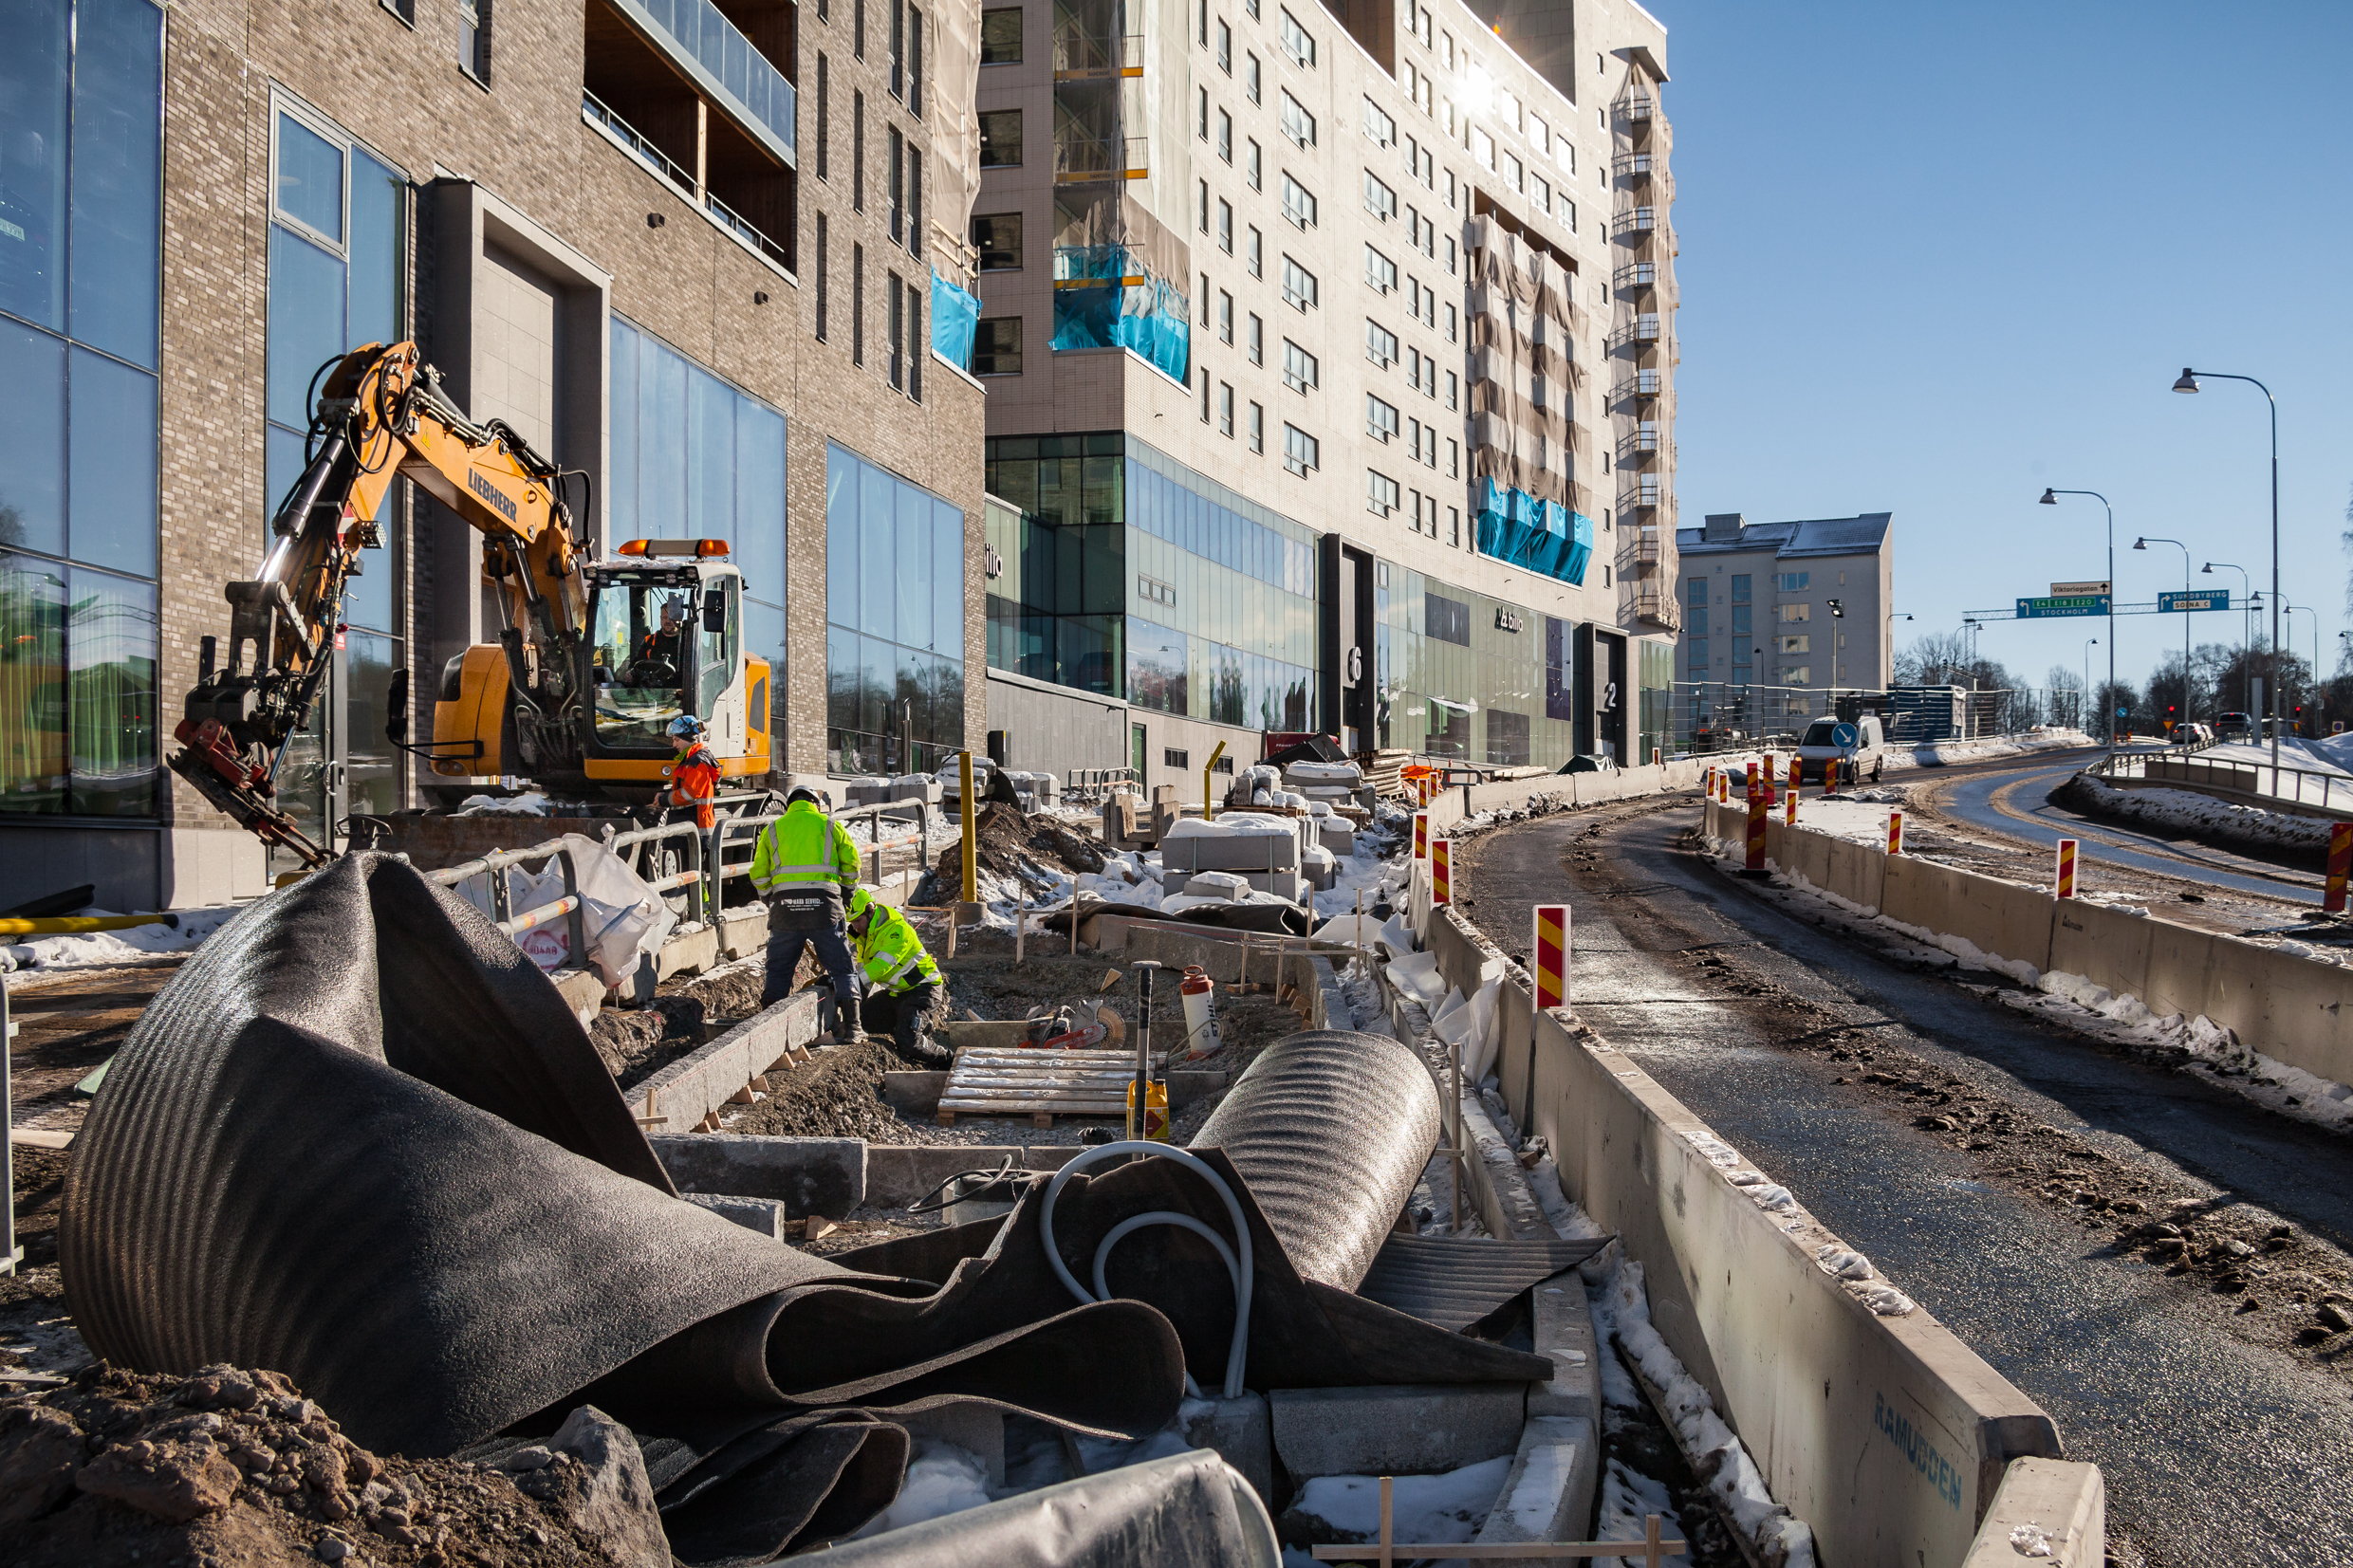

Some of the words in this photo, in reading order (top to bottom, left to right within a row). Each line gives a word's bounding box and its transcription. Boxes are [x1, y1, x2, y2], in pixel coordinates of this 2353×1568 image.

[468, 467, 516, 524] LIEBHERR
[985, 543, 1003, 578] ilia
[1509, 611, 1523, 632] bilia
[1352, 646, 1362, 681] 6
[1608, 682, 1617, 708] 2
[1875, 1391, 1962, 1511] RAMUDDEN
